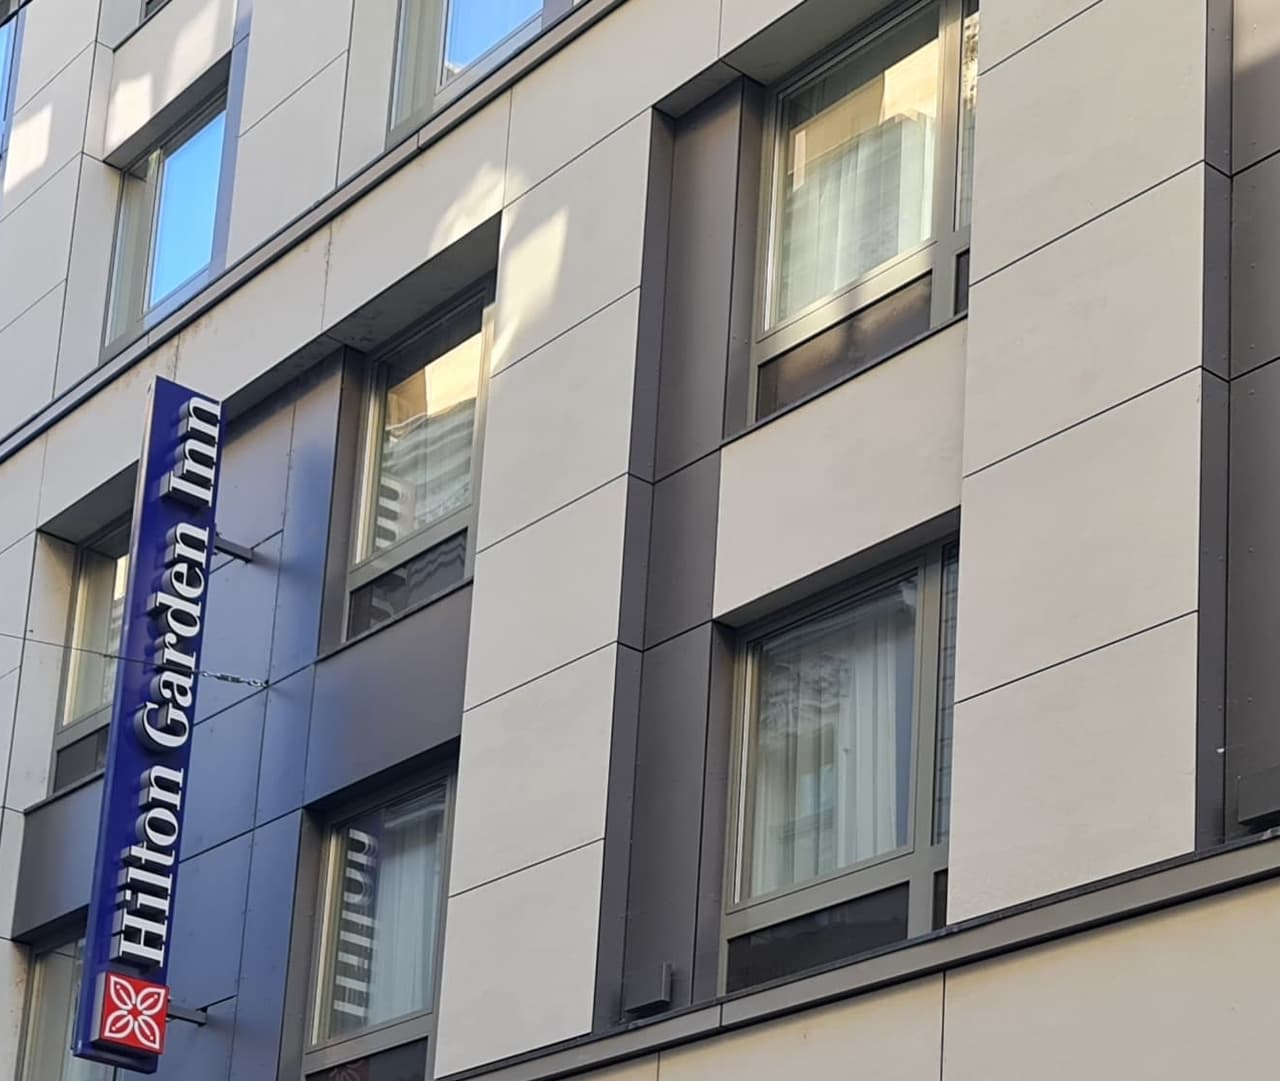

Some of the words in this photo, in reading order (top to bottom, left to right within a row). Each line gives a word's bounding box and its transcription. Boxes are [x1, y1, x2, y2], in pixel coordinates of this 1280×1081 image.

[166, 394, 222, 507] Inn
[144, 520, 210, 750] Garden
[118, 764, 184, 968] Hilton
